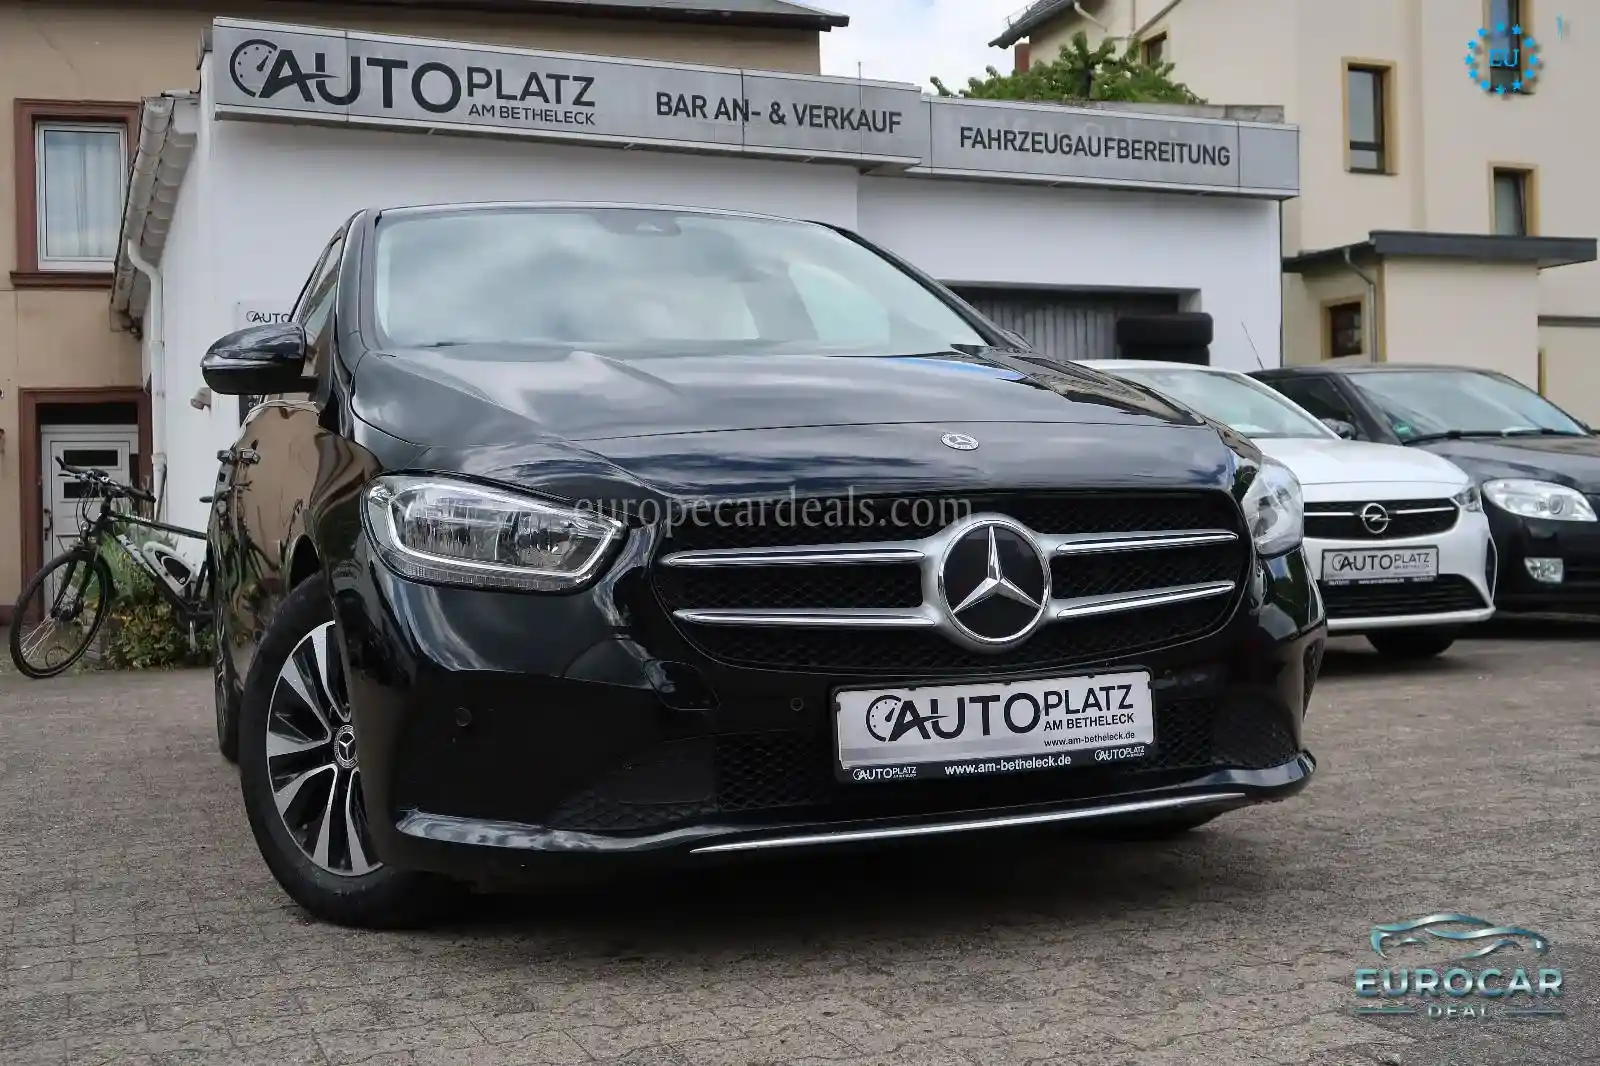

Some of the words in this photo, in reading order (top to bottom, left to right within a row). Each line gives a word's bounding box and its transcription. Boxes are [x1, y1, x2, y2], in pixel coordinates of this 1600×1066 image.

[468, 103, 495, 118] AM
[499, 105, 596, 126] BETHELECK
[656, 92, 708, 119] BAR
[714, 97, 761, 122] AN-
[769, 101, 786, 126] &
[793, 103, 903, 134] VERKAUF
[959, 126, 1231, 168] FAHRZEUGAUFBEREITUNG
[1043, 719, 1063, 732] AM
[1066, 712, 1135, 730] BETHELECK
[1043, 731, 1136, 748] www.am-betheleck.de
[944, 753, 1072, 776] www.am-betheleck.de
